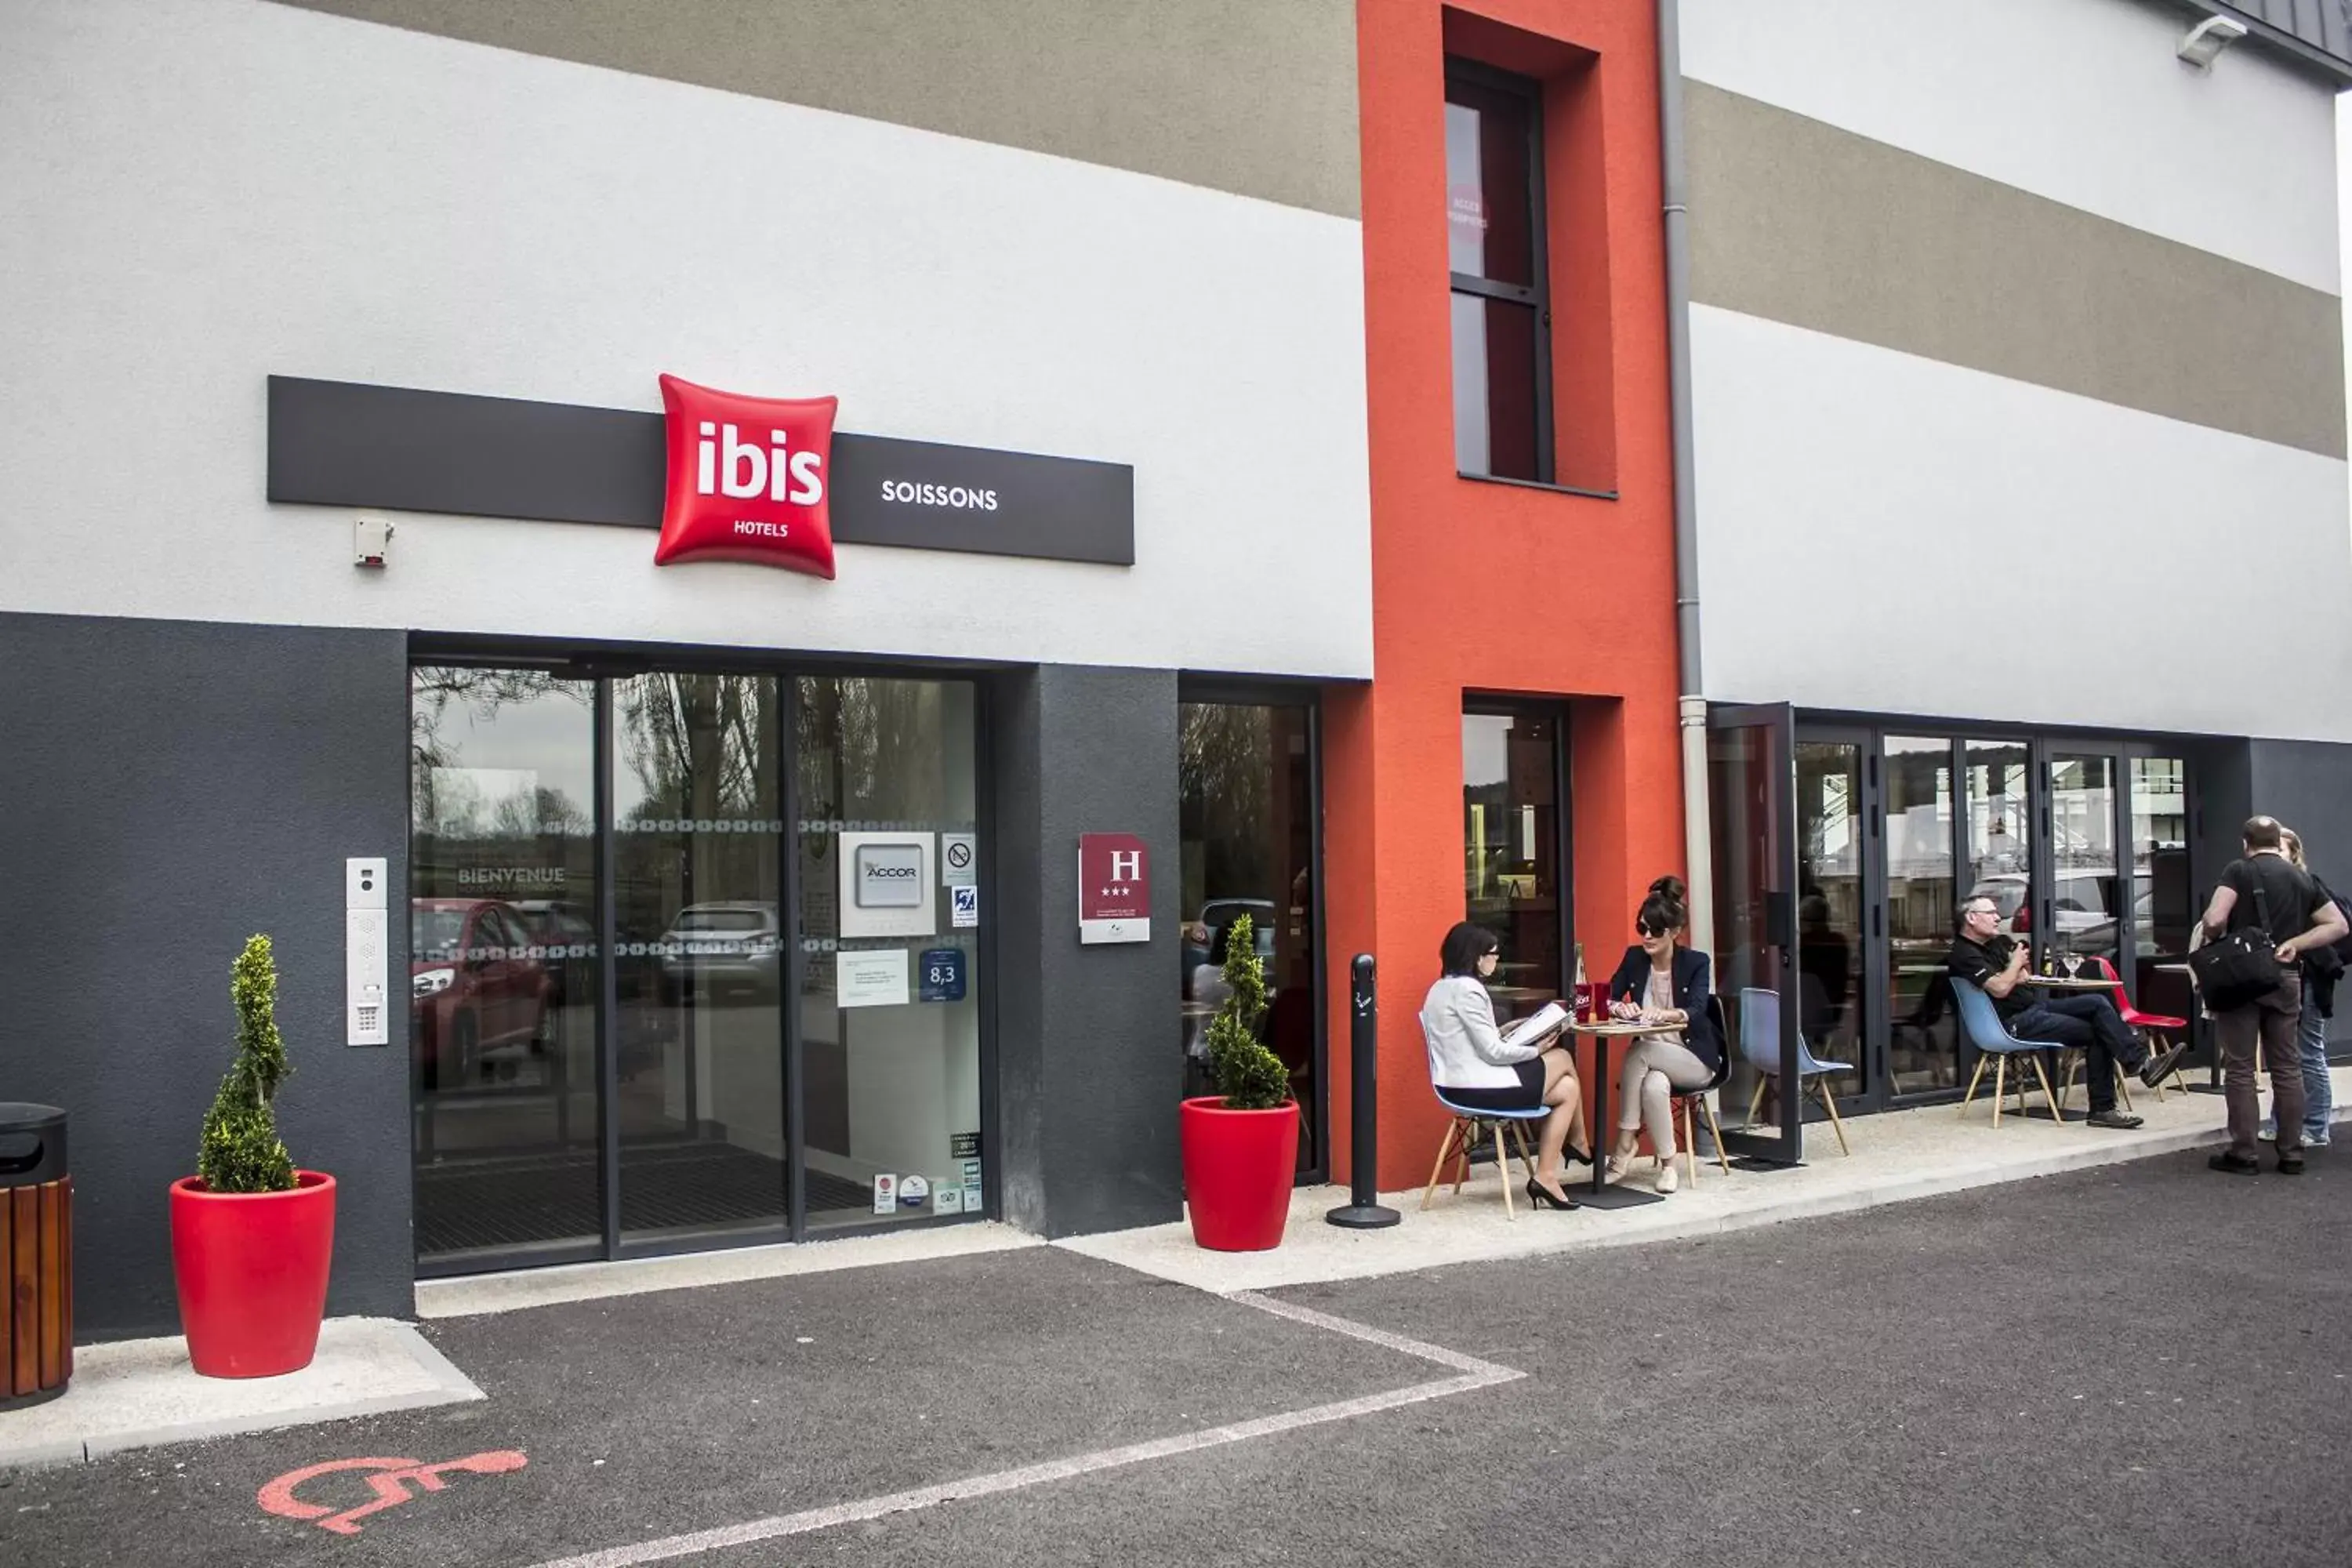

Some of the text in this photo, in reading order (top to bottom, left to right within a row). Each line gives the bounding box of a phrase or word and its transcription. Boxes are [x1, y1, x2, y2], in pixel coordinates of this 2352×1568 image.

[698, 422, 823, 506] ibis
[881, 481, 998, 511] SOISSONS
[734, 520, 789, 538] HOTELS
[459, 867, 565, 884] BIENVENUE
[867, 867, 916, 877] ACCOR
[1110, 851, 1142, 881] H
[930, 966, 955, 985] 8,3
